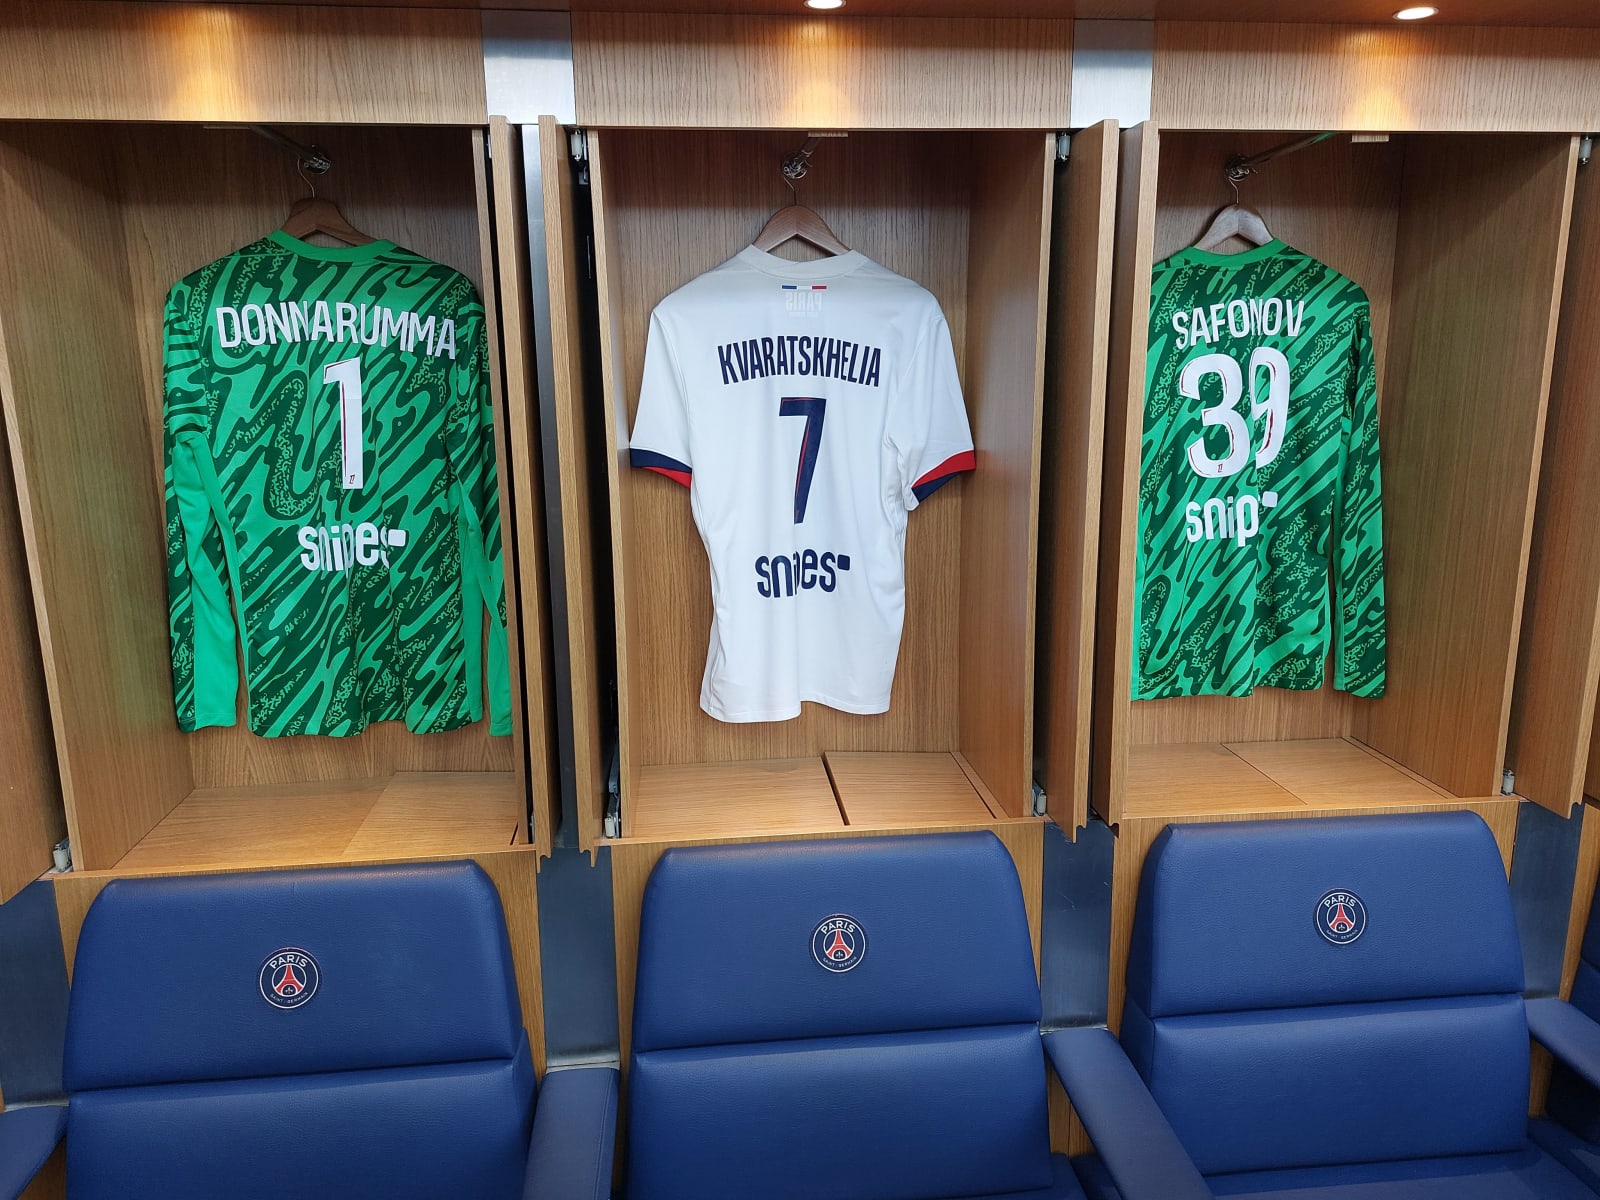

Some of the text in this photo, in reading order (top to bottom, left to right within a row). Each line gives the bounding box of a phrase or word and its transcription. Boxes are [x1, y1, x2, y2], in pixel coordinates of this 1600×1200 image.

[215, 300, 456, 360] DONNARUMMA
[1172, 297, 1305, 350] SAFONOV
[717, 335, 882, 387] KVARATSKHELIA
[323, 356, 364, 490] 1
[1179, 346, 1291, 479] 39
[778, 396, 828, 524] 7
[1185, 494, 1260, 548] snip
[821, 920, 856, 934] PARIS
[1324, 895, 1356, 907] PARIS
[269, 955, 308, 969] PARIS
